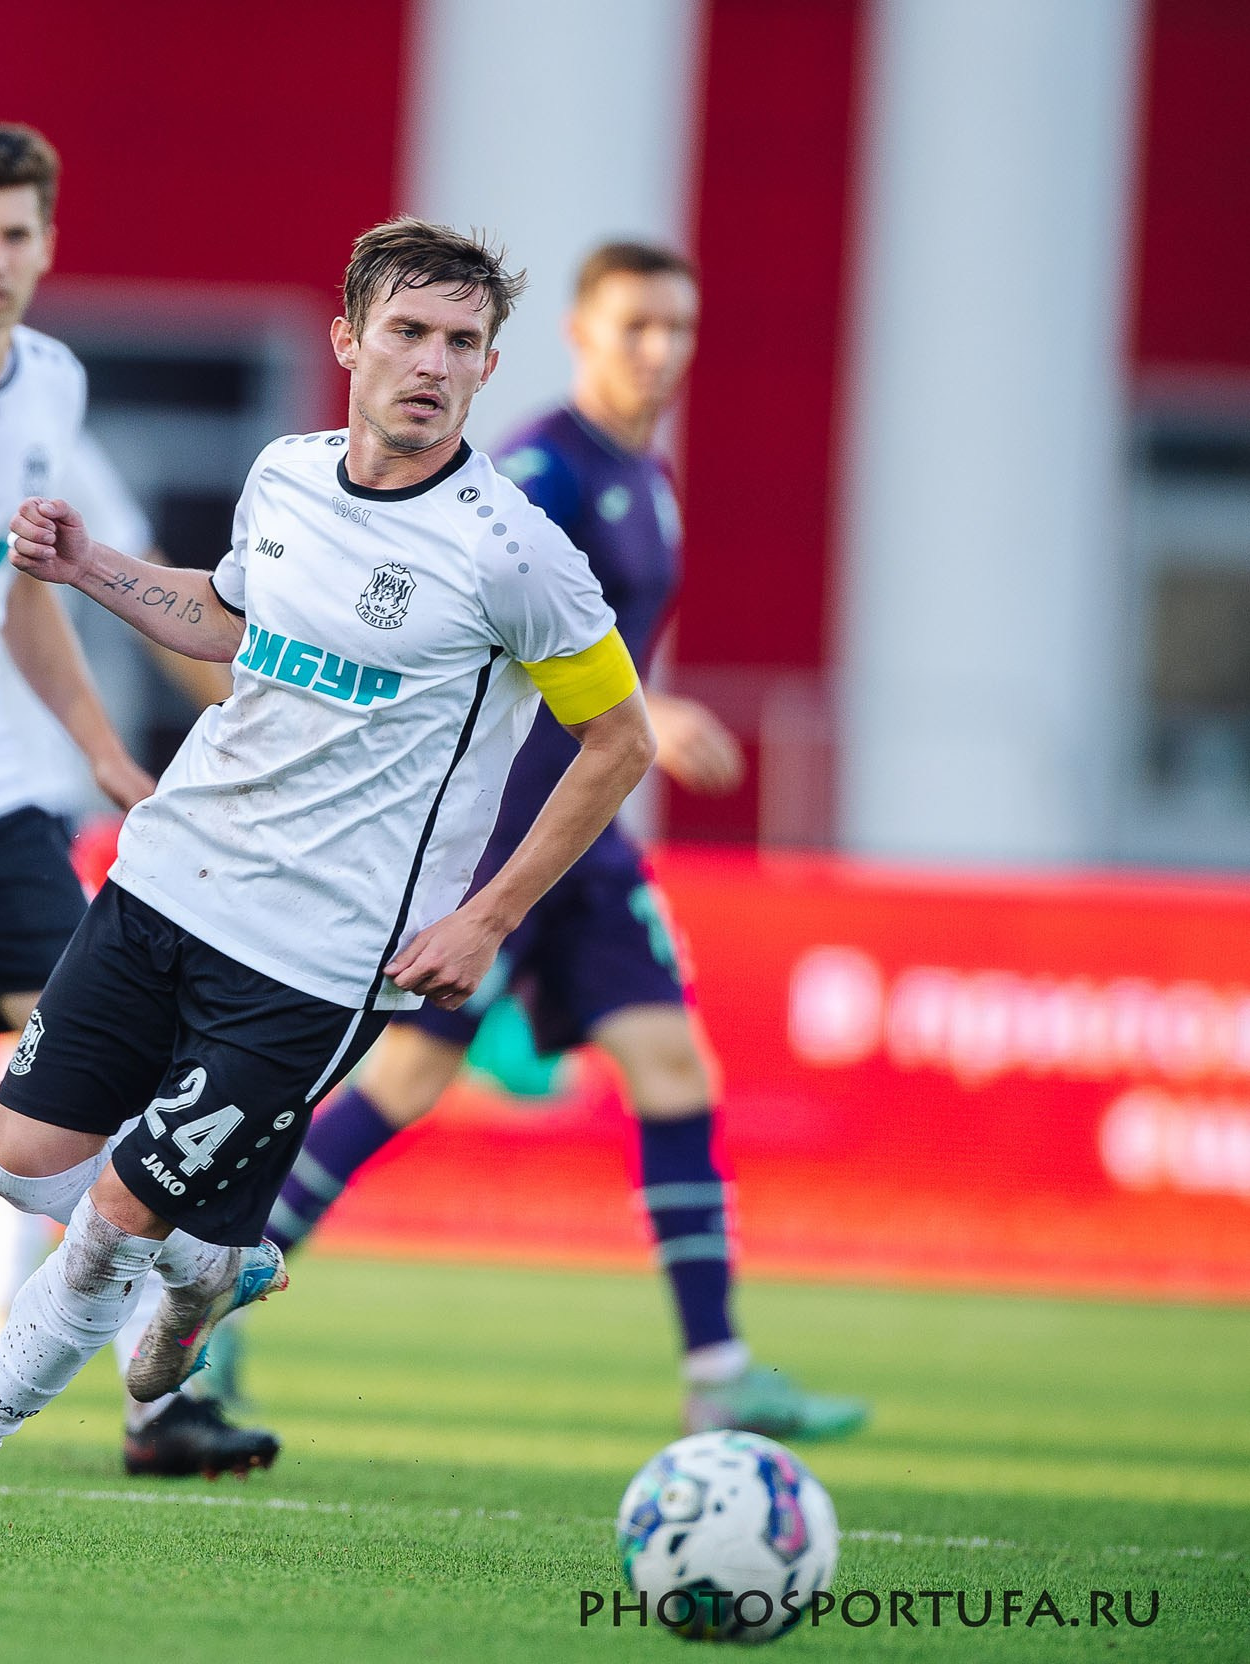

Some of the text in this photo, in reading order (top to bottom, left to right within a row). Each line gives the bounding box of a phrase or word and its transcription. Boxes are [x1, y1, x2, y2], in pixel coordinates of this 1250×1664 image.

[331, 496, 372, 528] 1961
[255, 537, 285, 559] JAKO
[103, 572, 204, 624] 24.09.15
[373, 604, 387, 615] ФК
[358, 604, 399, 627] ТЮМЕНЬ
[143, 1066, 246, 1177] 24
[141, 1153, 186, 1196] JAKO
